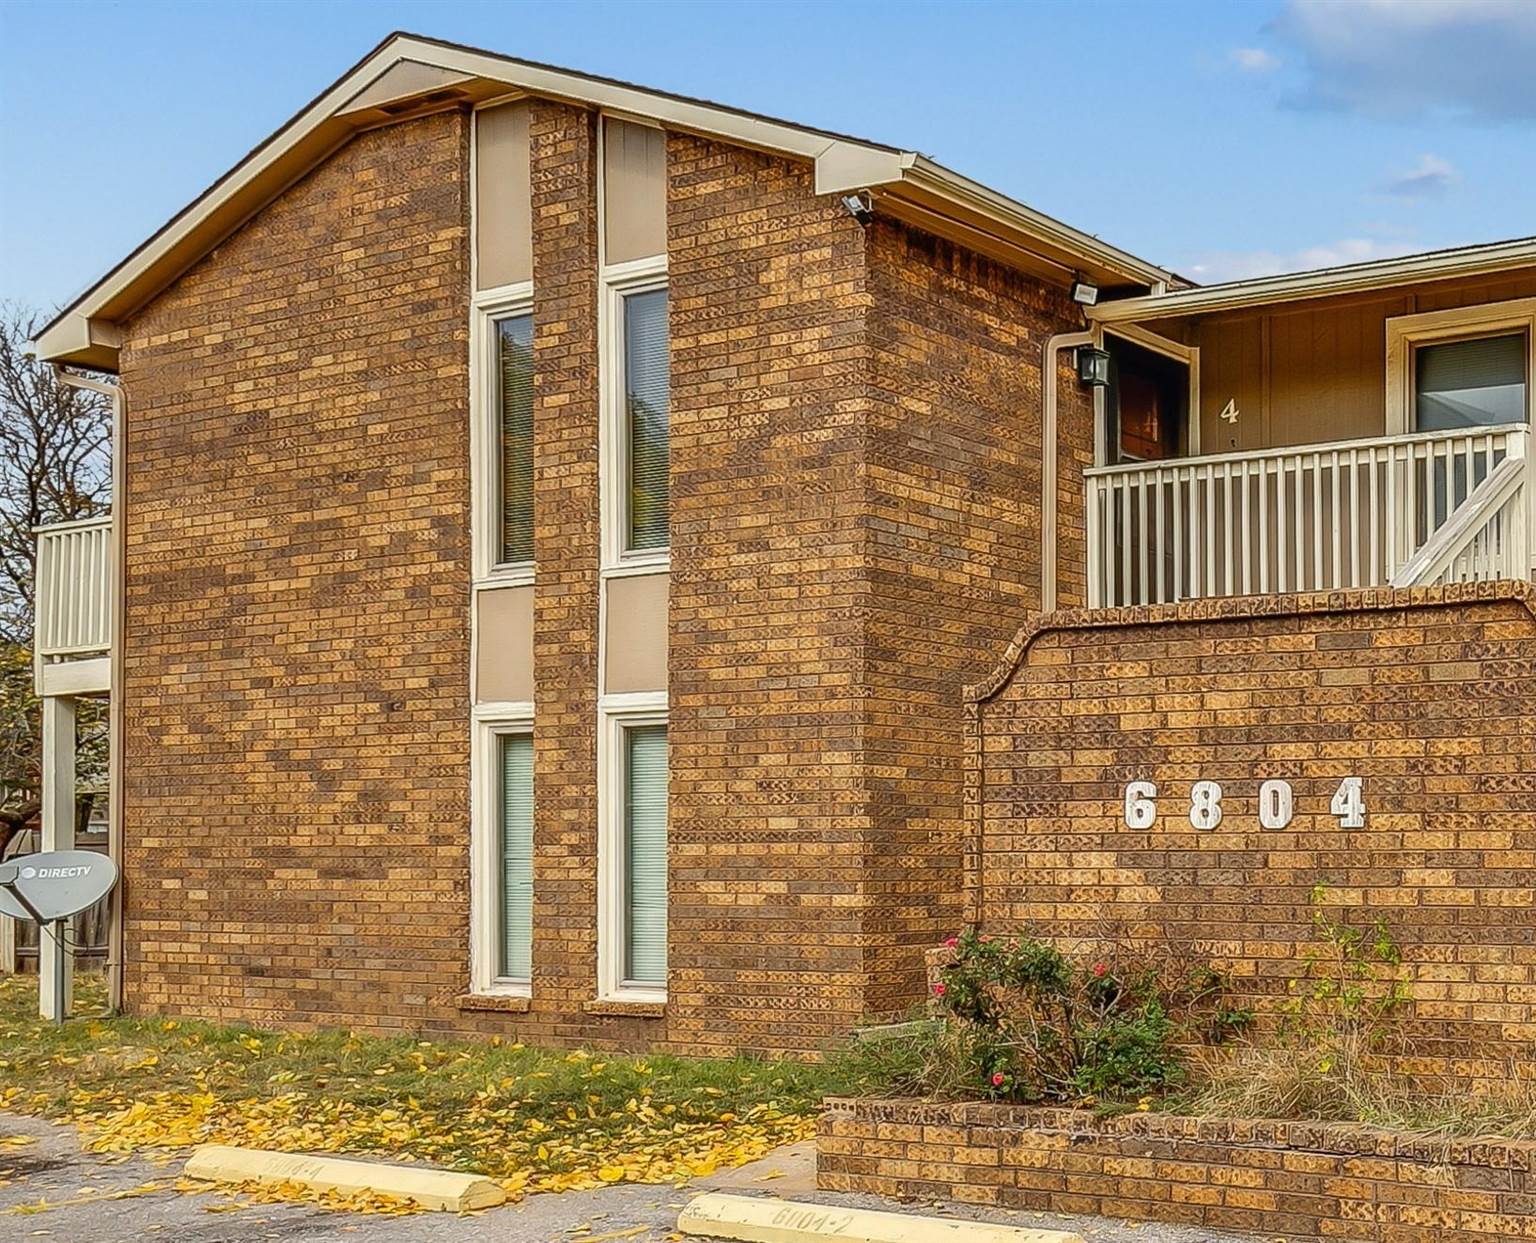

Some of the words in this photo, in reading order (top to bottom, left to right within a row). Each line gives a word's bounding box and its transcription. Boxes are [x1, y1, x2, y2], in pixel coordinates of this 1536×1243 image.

[1220, 398, 1240, 424] 4
[1124, 776, 1366, 830] 6804
[38, 866, 91, 878] DIRECTV
